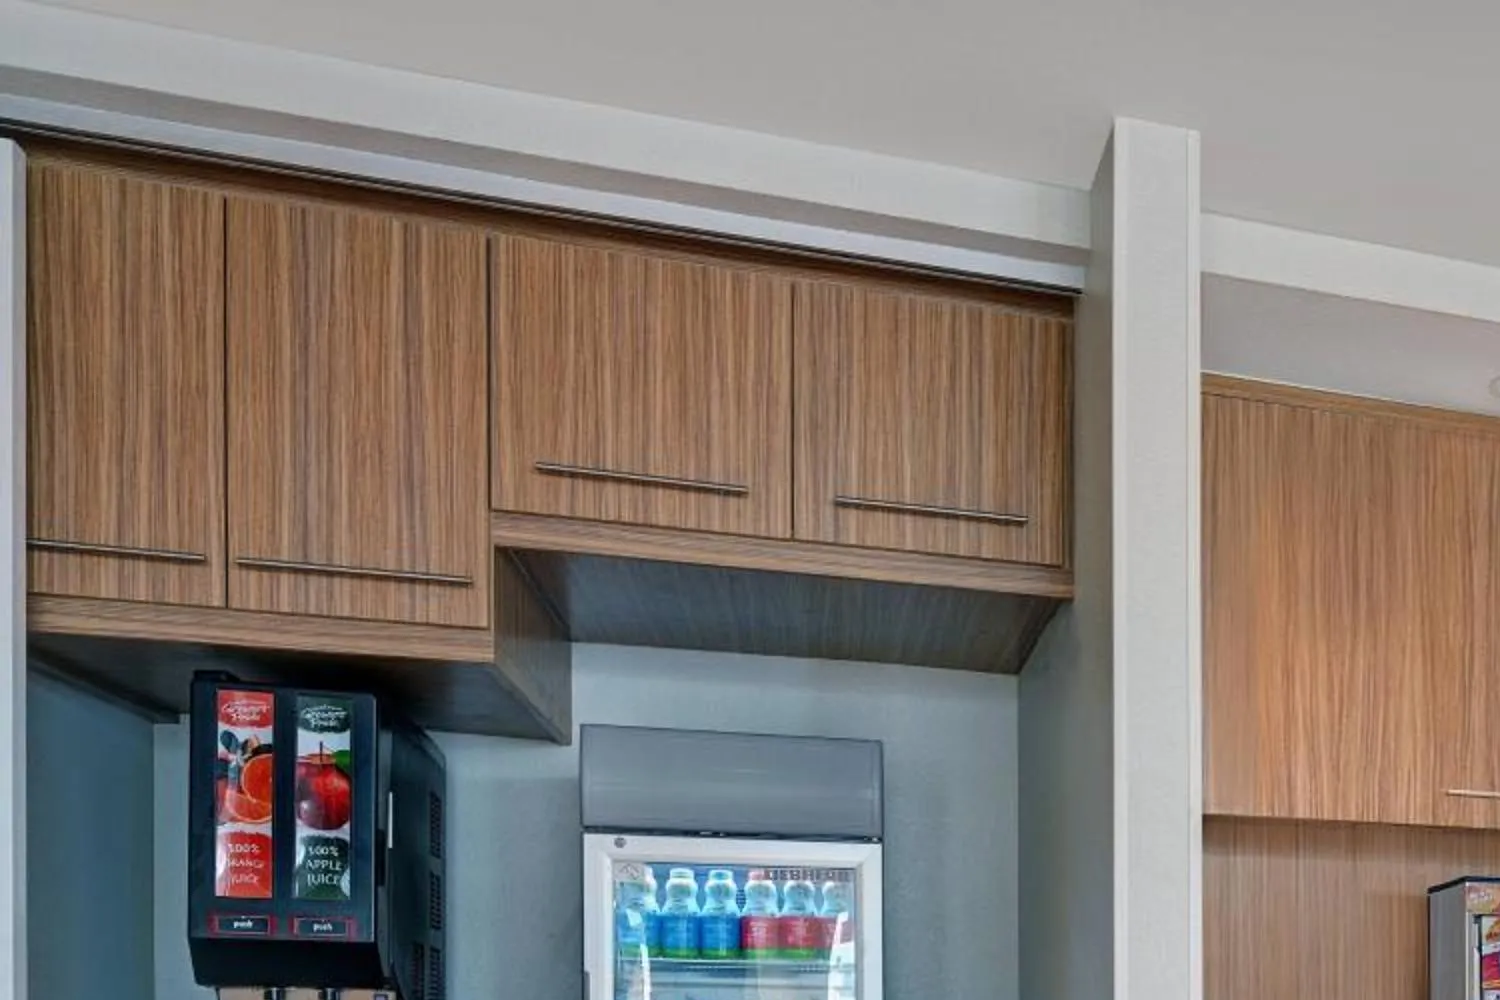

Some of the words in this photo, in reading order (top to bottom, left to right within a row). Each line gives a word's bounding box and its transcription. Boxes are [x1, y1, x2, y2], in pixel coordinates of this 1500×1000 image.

[228, 843, 261, 853] 100%
[308, 845, 339, 857] 100%
[305, 859, 342, 871] APPLE
[307, 874, 339, 886] JUICE
